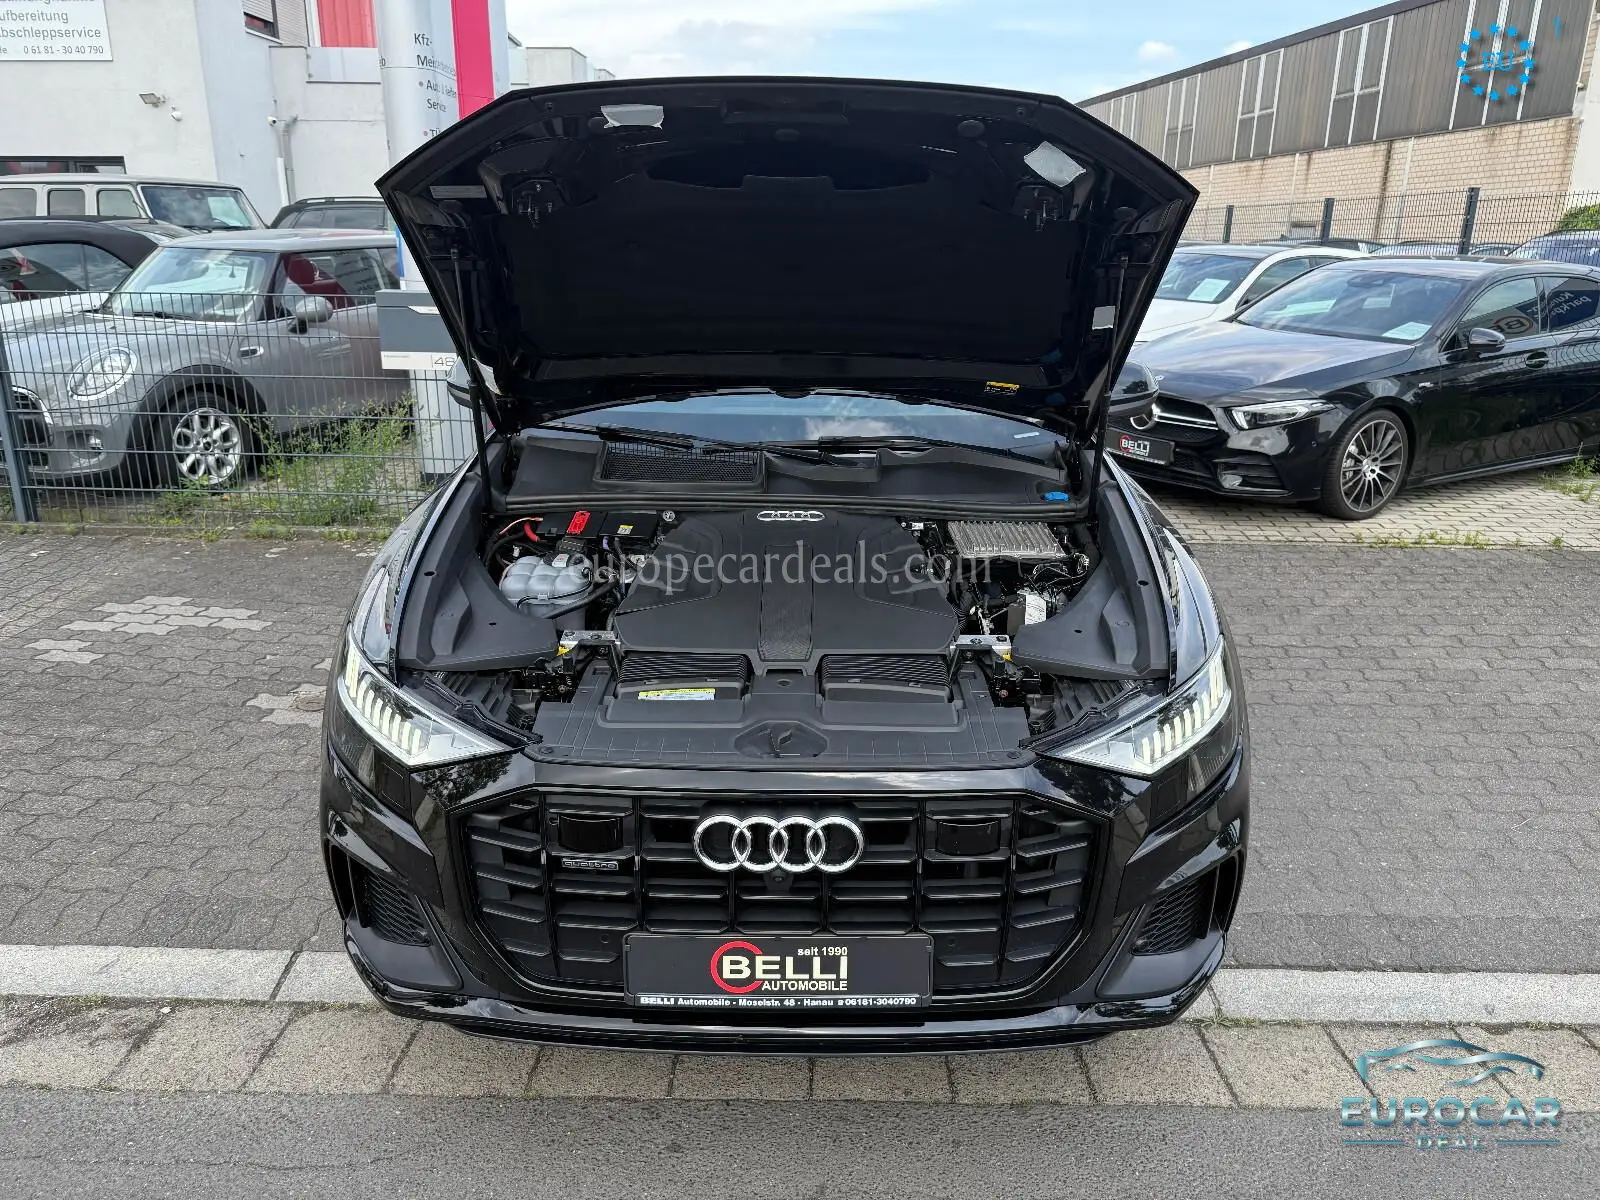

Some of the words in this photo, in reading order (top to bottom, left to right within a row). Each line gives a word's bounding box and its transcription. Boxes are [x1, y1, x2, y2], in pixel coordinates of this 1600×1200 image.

[0, 26, 101, 40] bschleppservice
[62, 45, 73, 54] 30
[74, 45, 86, 54] 40
[88, 45, 104, 54] 790
[564, 861, 617, 869] quattro
[797, 947, 819, 956] seit
[821, 947, 848, 956] 1990
[722, 955, 848, 979] BELLI
[761, 981, 848, 991] AUTOMOBILE
[640, 997, 675, 1005] BELLI
[677, 998, 731, 1006] Automobile
